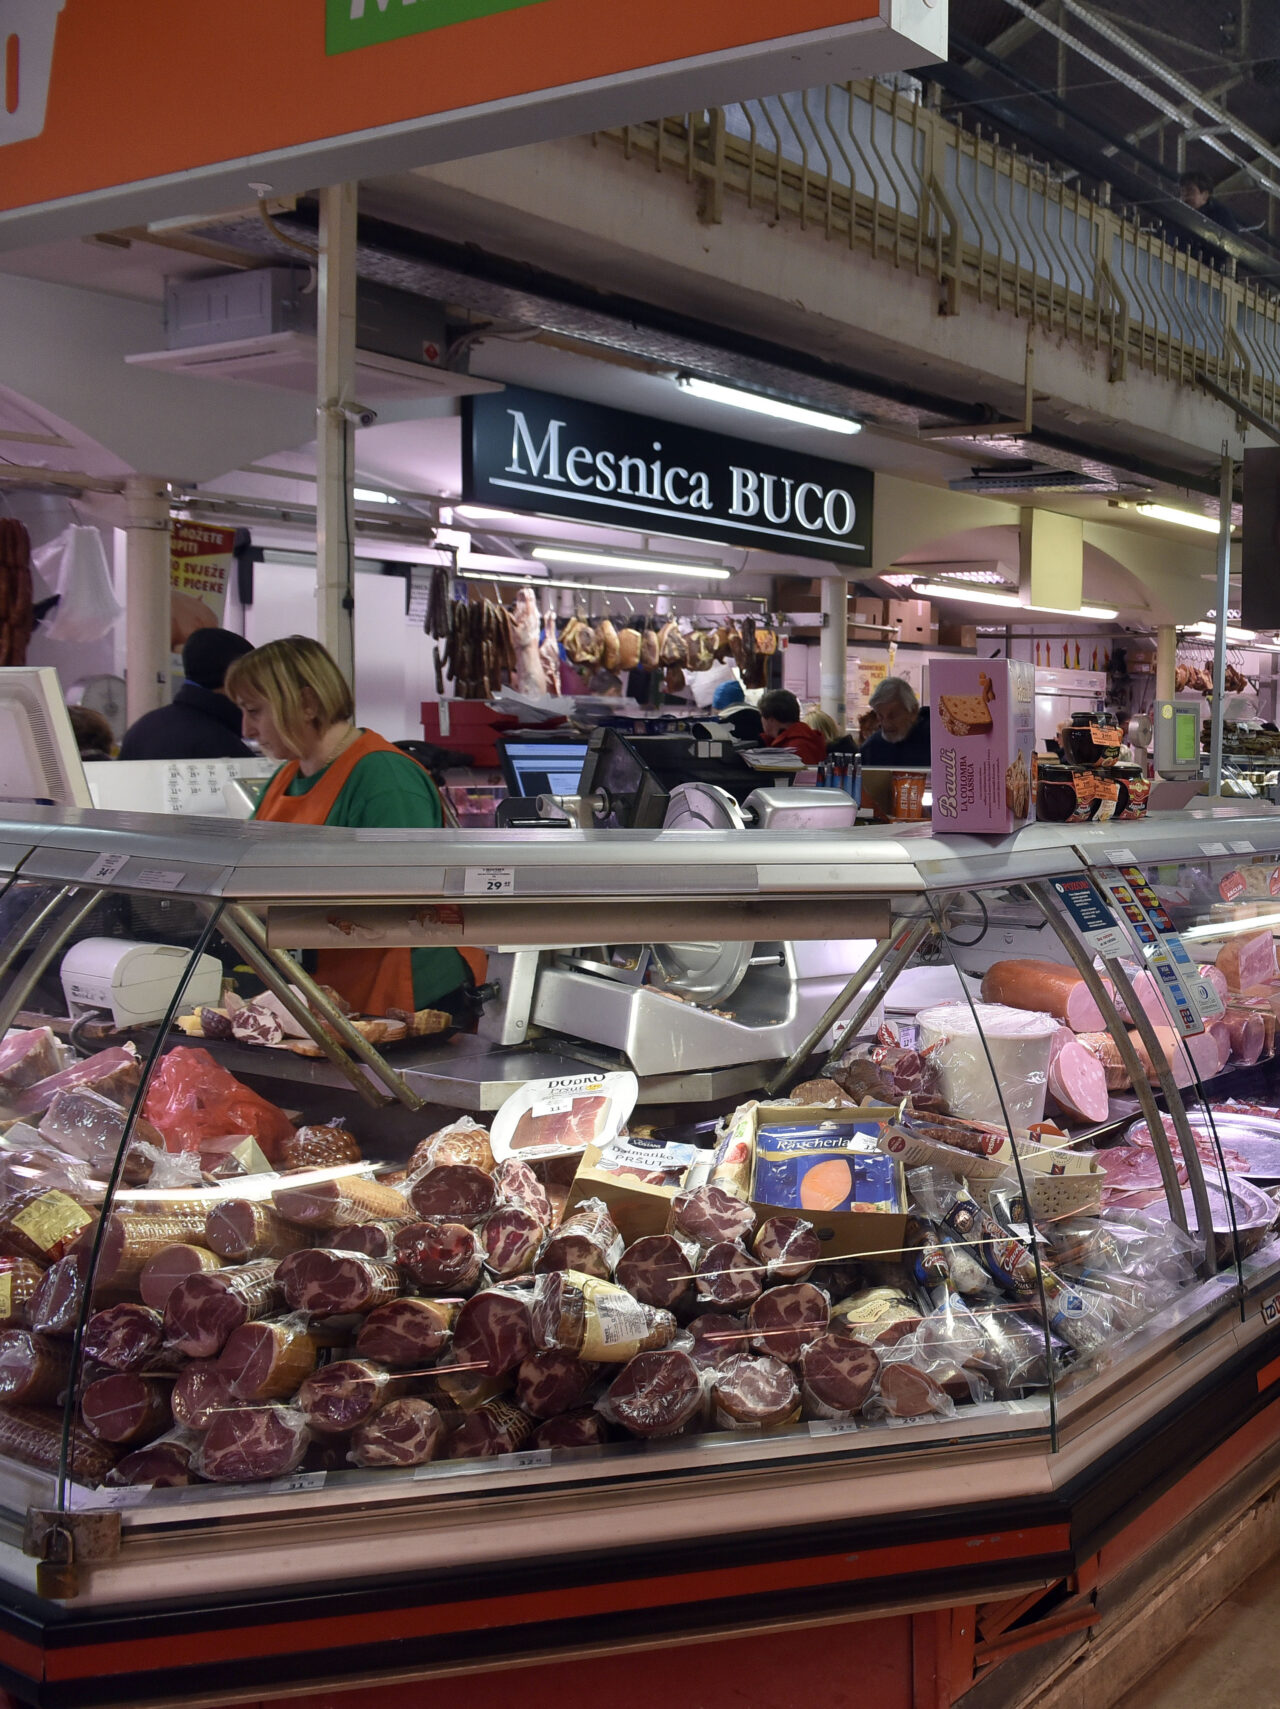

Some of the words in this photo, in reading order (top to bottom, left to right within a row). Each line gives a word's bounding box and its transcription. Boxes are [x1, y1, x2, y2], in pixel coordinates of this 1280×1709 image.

[505, 408, 713, 510] Mesnica
[728, 465, 856, 535] BUCO
[937, 747, 958, 819] Bauli
[959, 755, 968, 799] COLOMBA
[967, 762, 975, 805] CLASSICA
[960, 800, 968, 812] LA
[486, 881, 503, 891] 29
